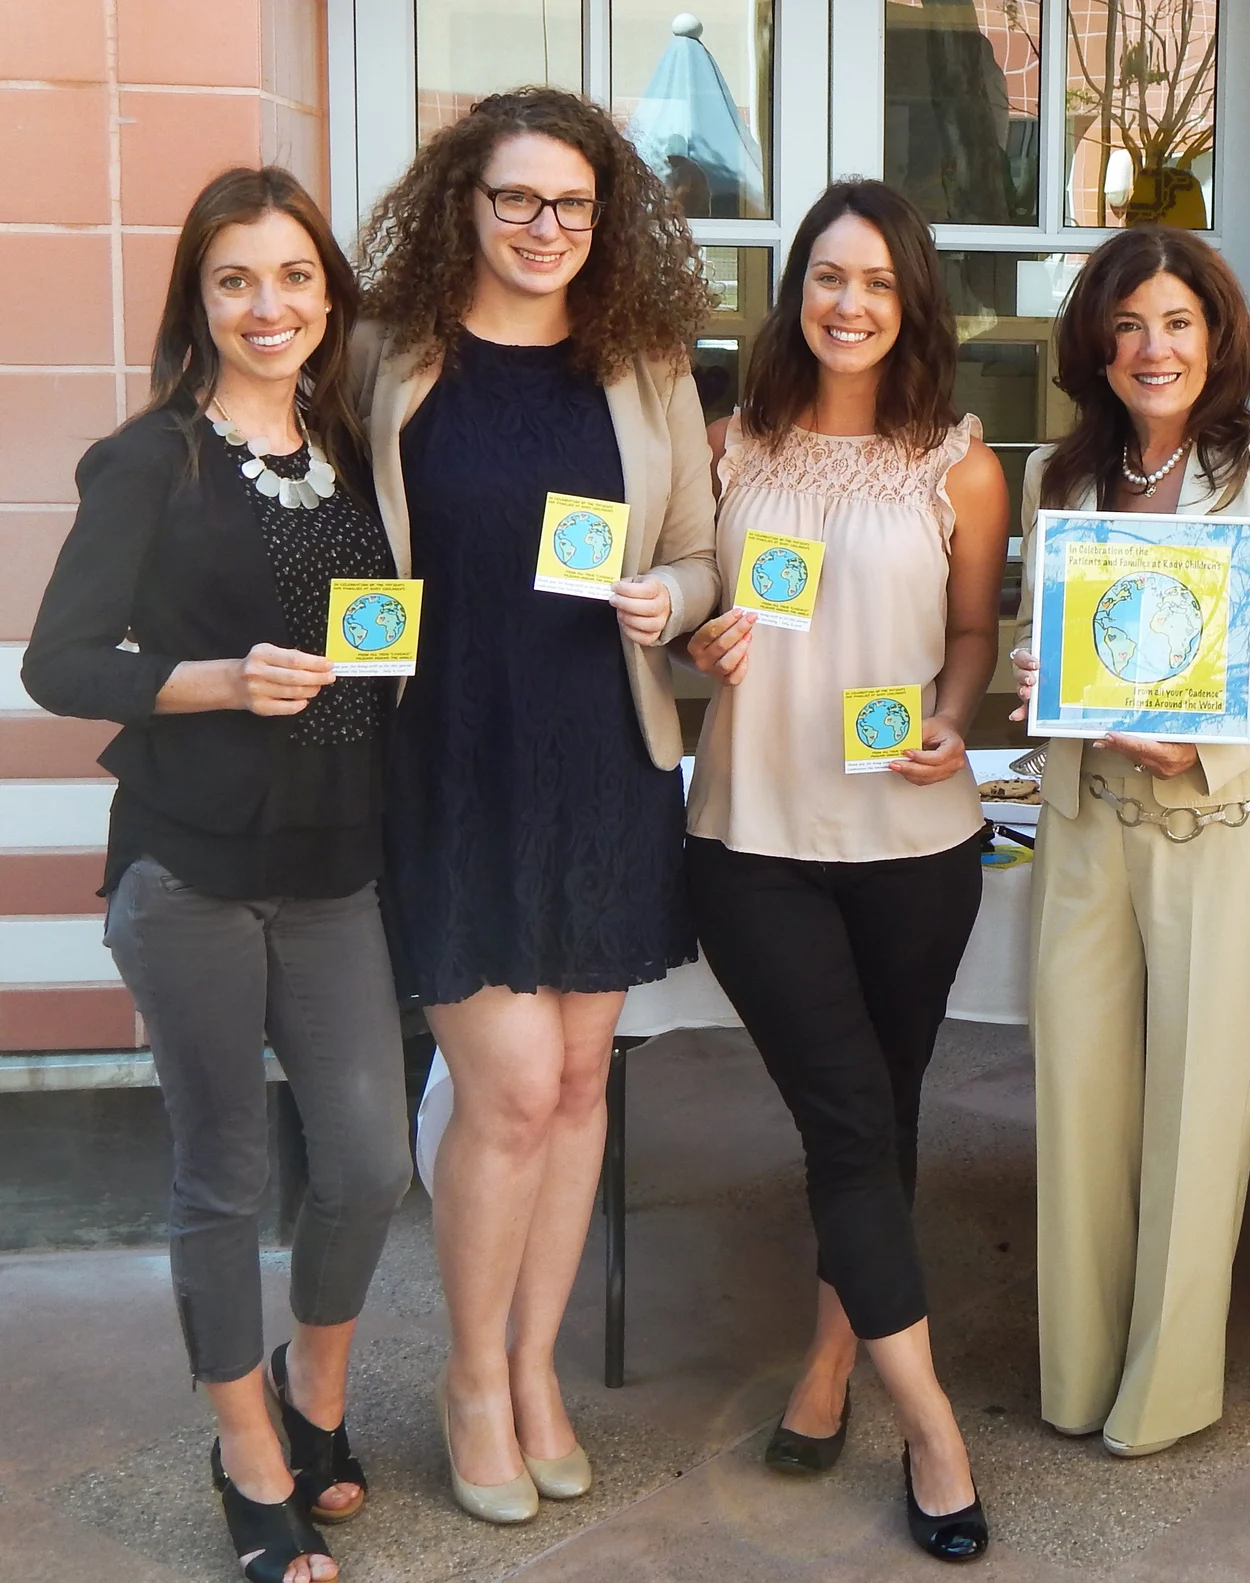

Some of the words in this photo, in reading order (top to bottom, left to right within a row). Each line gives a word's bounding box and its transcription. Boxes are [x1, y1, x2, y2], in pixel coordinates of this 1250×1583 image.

[1069, 545, 1078, 554] In
[1079, 545, 1123, 556] Celebration
[1124, 546, 1134, 556] of
[1135, 547, 1149, 556] the
[1068, 556, 1101, 566] Patients
[1103, 558, 1118, 567] and
[1151, 560, 1162, 568] at
[1163, 559, 1184, 570] Rady
[1166, 689, 1184, 698] your
[1154, 699, 1183, 709] Around
[1184, 700, 1197, 710] the
[1199, 700, 1223, 711] World
